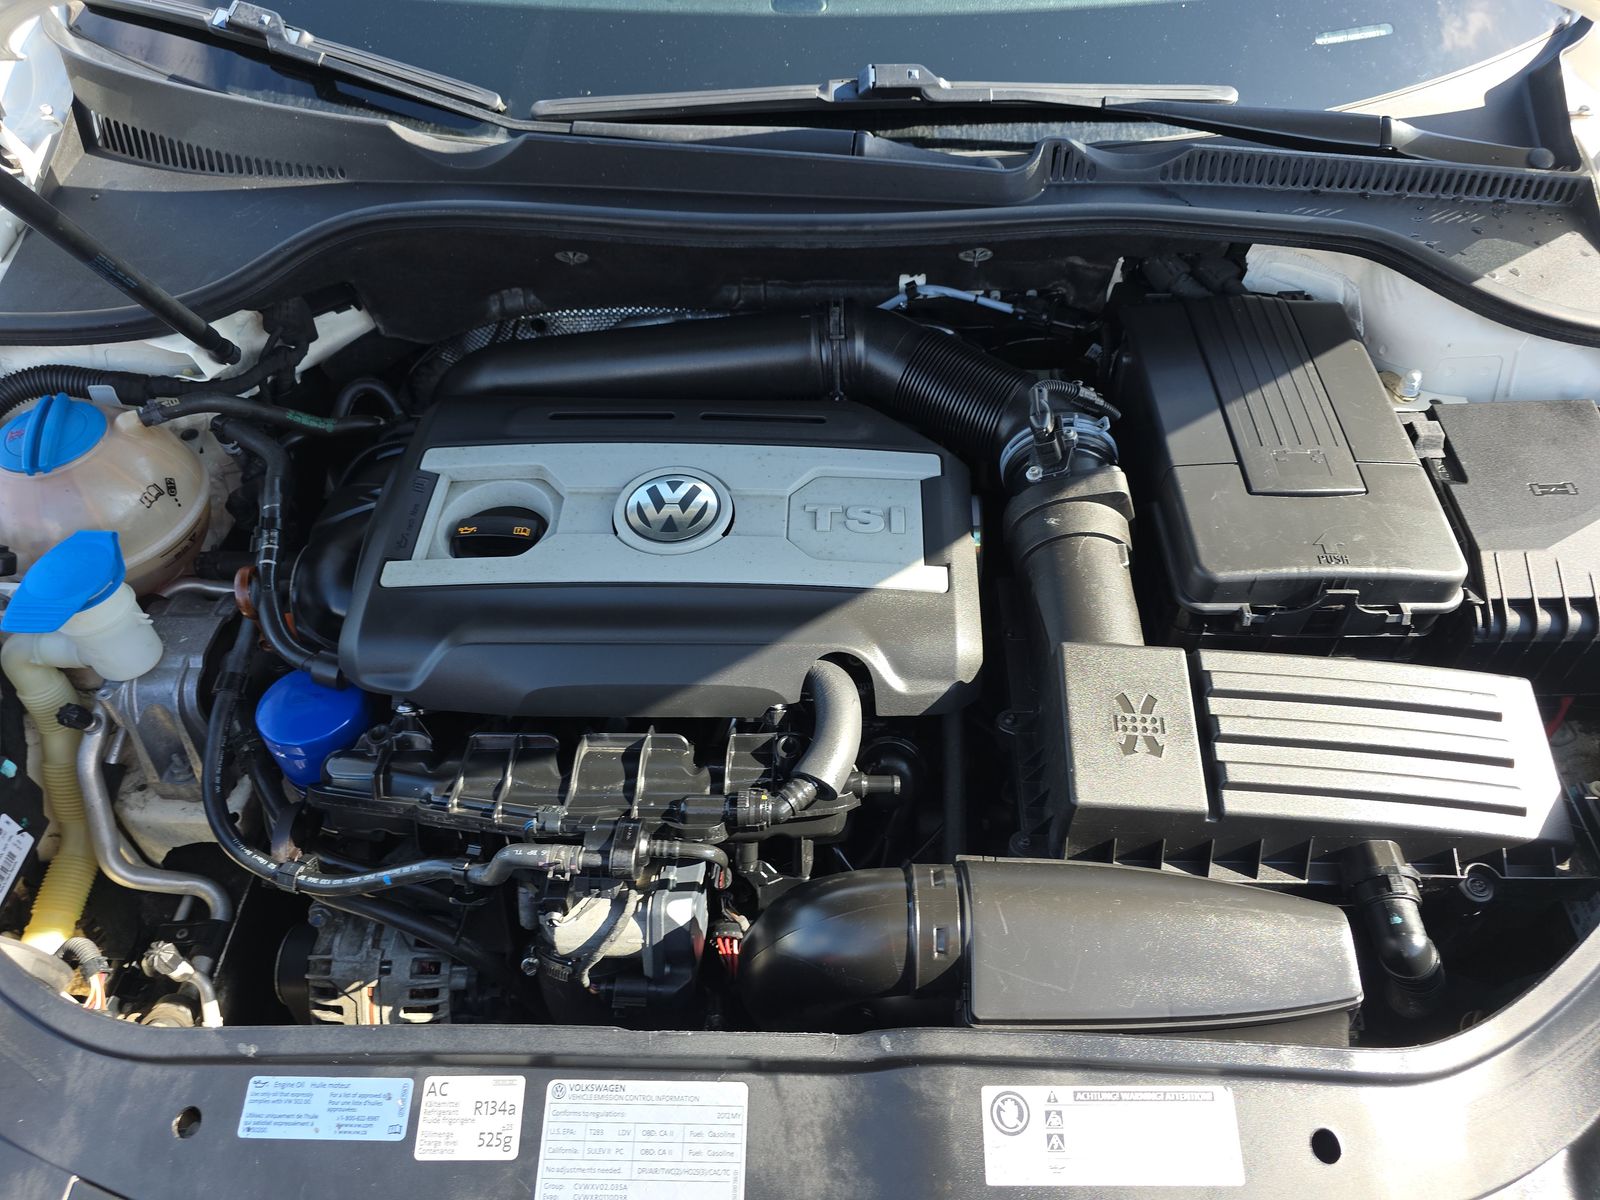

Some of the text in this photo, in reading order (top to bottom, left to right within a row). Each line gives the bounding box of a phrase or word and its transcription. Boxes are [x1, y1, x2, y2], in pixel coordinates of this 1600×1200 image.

[165, 477, 177, 497] G12
[803, 503, 907, 535] TSI
[1317, 554, 1350, 565] PUSH
[274, 1081, 294, 1089] Engine
[426, 1081, 449, 1097] AC
[569, 1083, 626, 1092] VOLKSWAGEN
[568, 1093, 593, 1101] VEHICLE
[625, 1094, 655, 1102] CONTROL
[656, 1095, 700, 1103] INFORMATION
[474, 1100, 516, 1116] R134a
[707, 1130, 736, 1139] Gasoline
[478, 1131, 513, 1153] 525g
[706, 1149, 735, 1158] Gasoline
